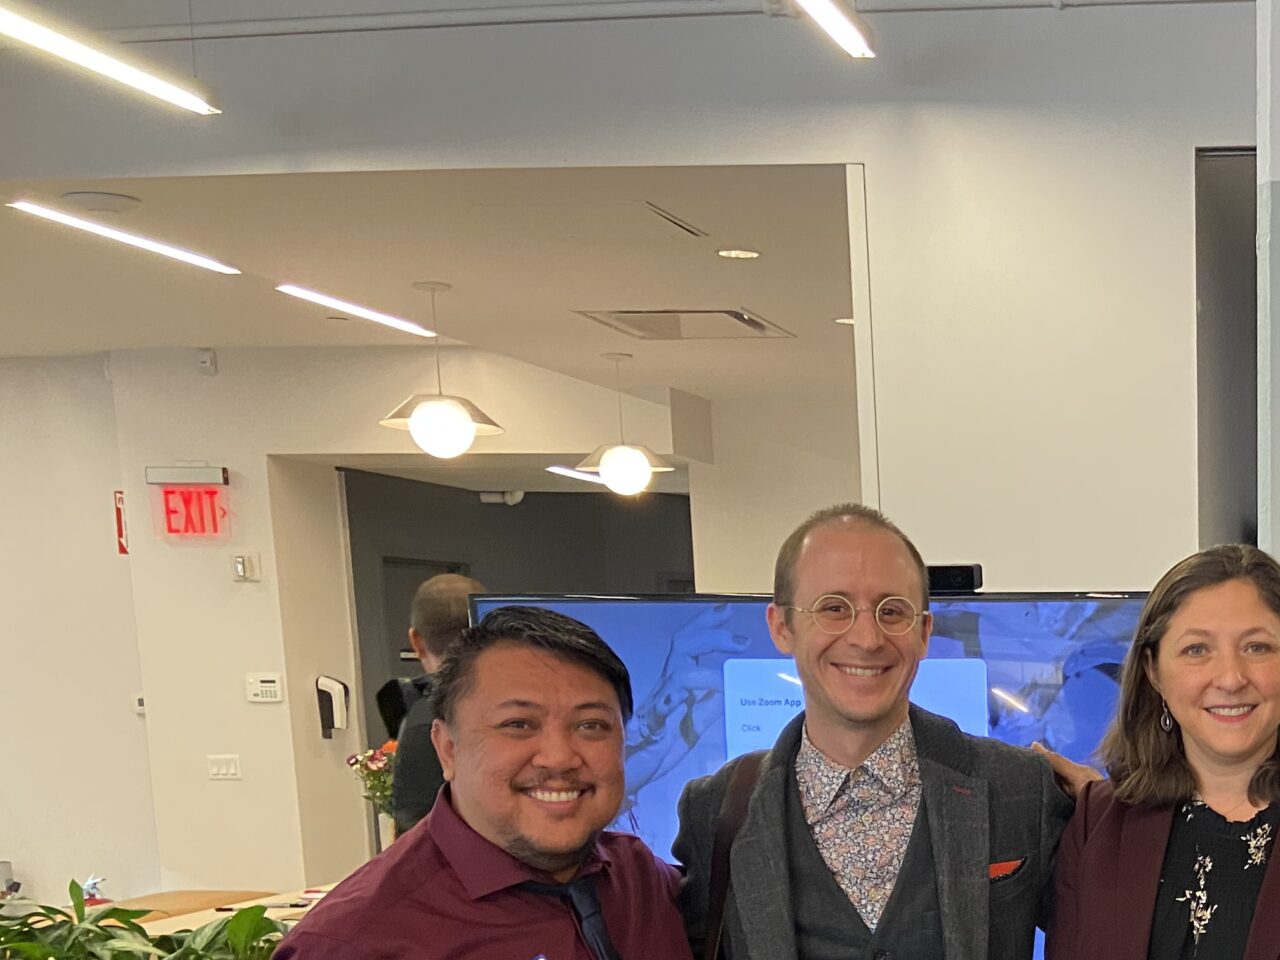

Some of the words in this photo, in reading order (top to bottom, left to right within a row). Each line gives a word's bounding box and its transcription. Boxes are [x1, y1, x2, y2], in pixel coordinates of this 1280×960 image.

[163, 489, 218, 534] EXIT
[740, 698, 757, 707] Use
[758, 698, 783, 707] Zoom
[741, 723, 761, 733] Click
